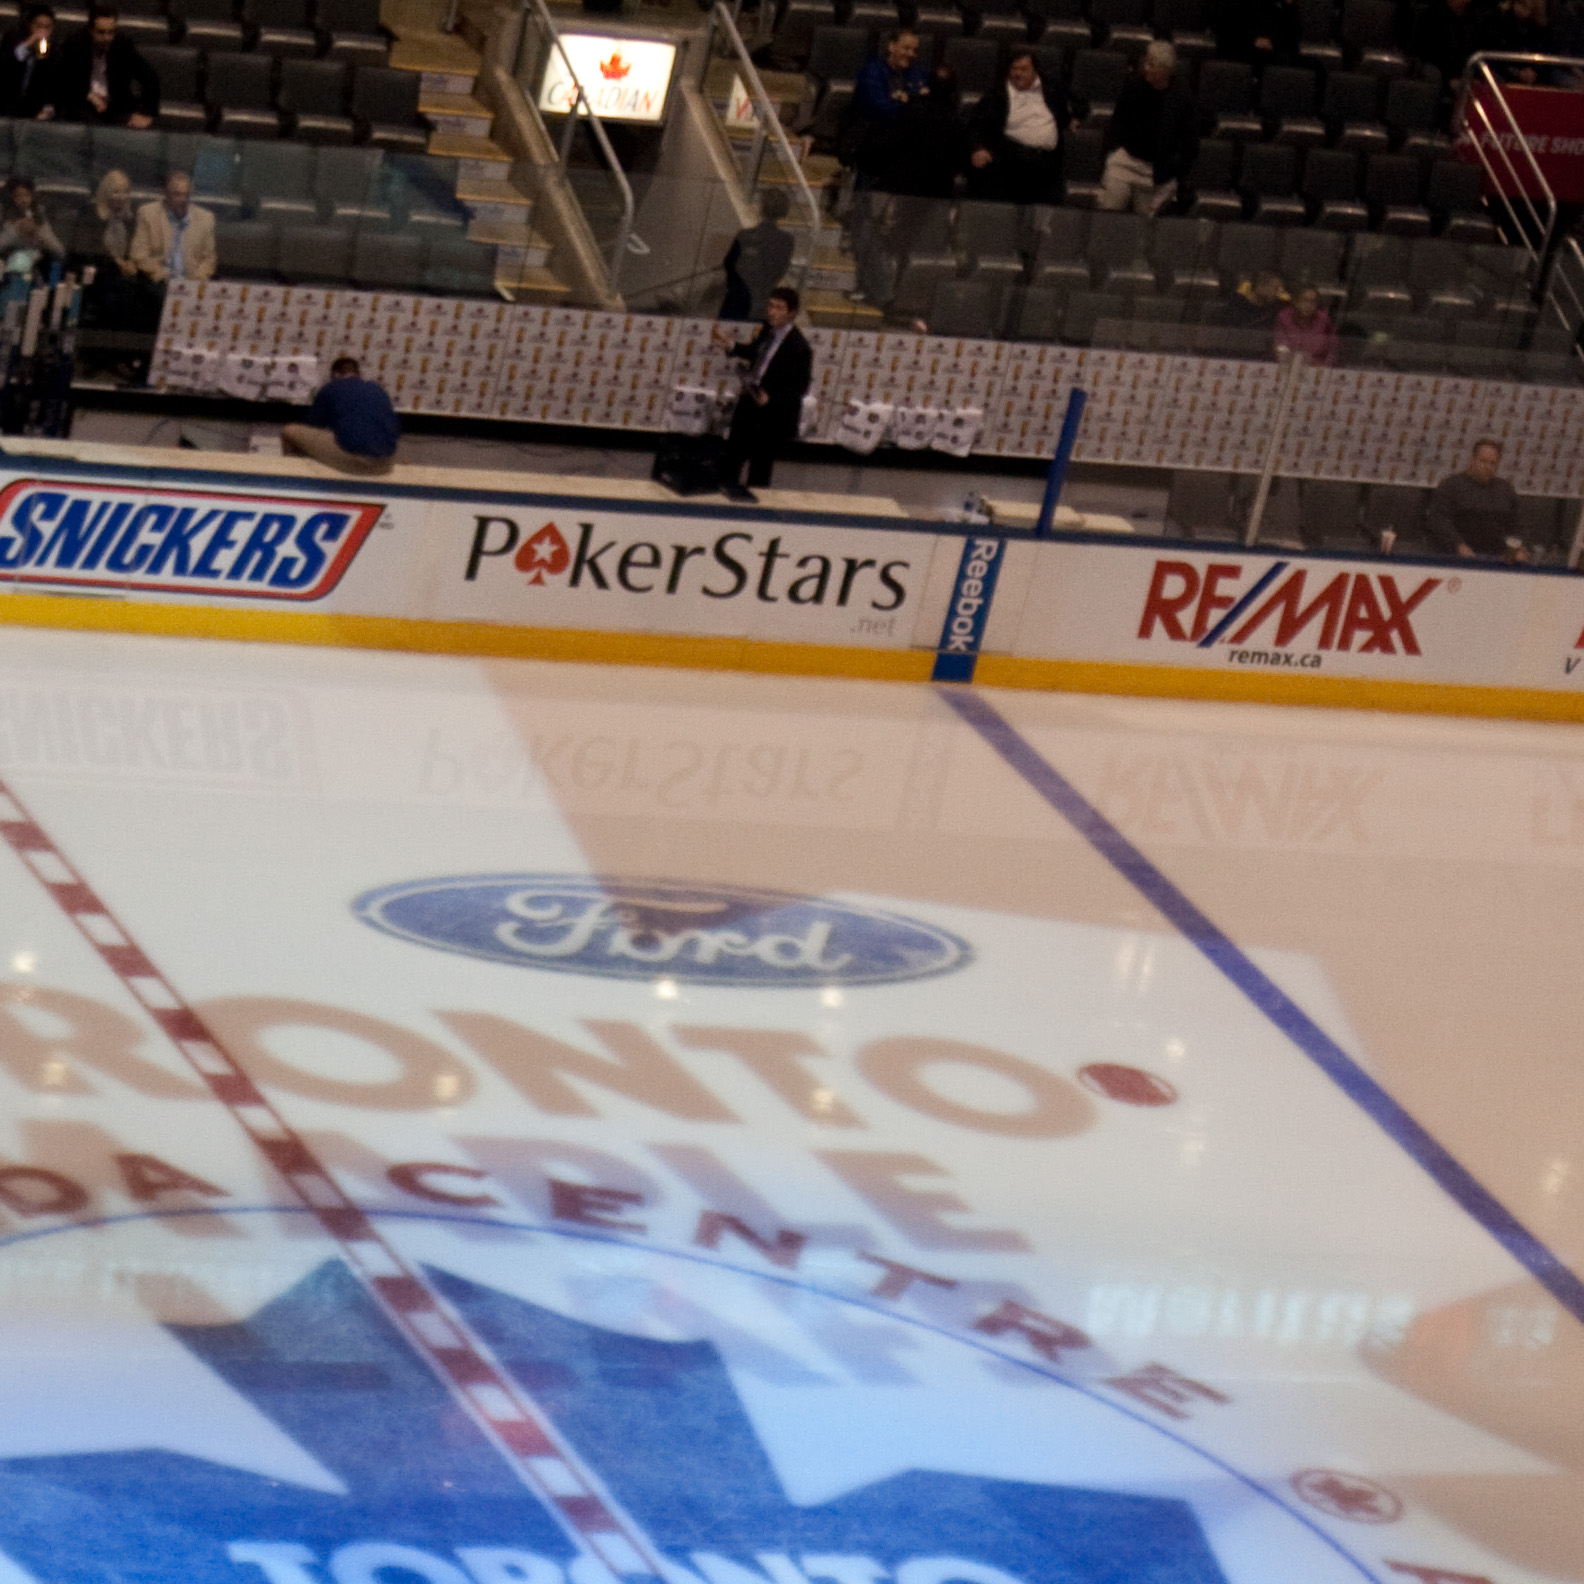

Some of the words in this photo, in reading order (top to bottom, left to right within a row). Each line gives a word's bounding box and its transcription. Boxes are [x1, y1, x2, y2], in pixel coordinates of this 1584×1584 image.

[463, 514, 912, 612] PokerStars
[947, 536, 1002, 652] Reebok
[1136, 558, 1444, 657] RE/MAX
[1227, 646, 1324, 671] remax.ca
[494, 886, 853, 970] Ford
[384, 1160, 1235, 1421] CENTRE
